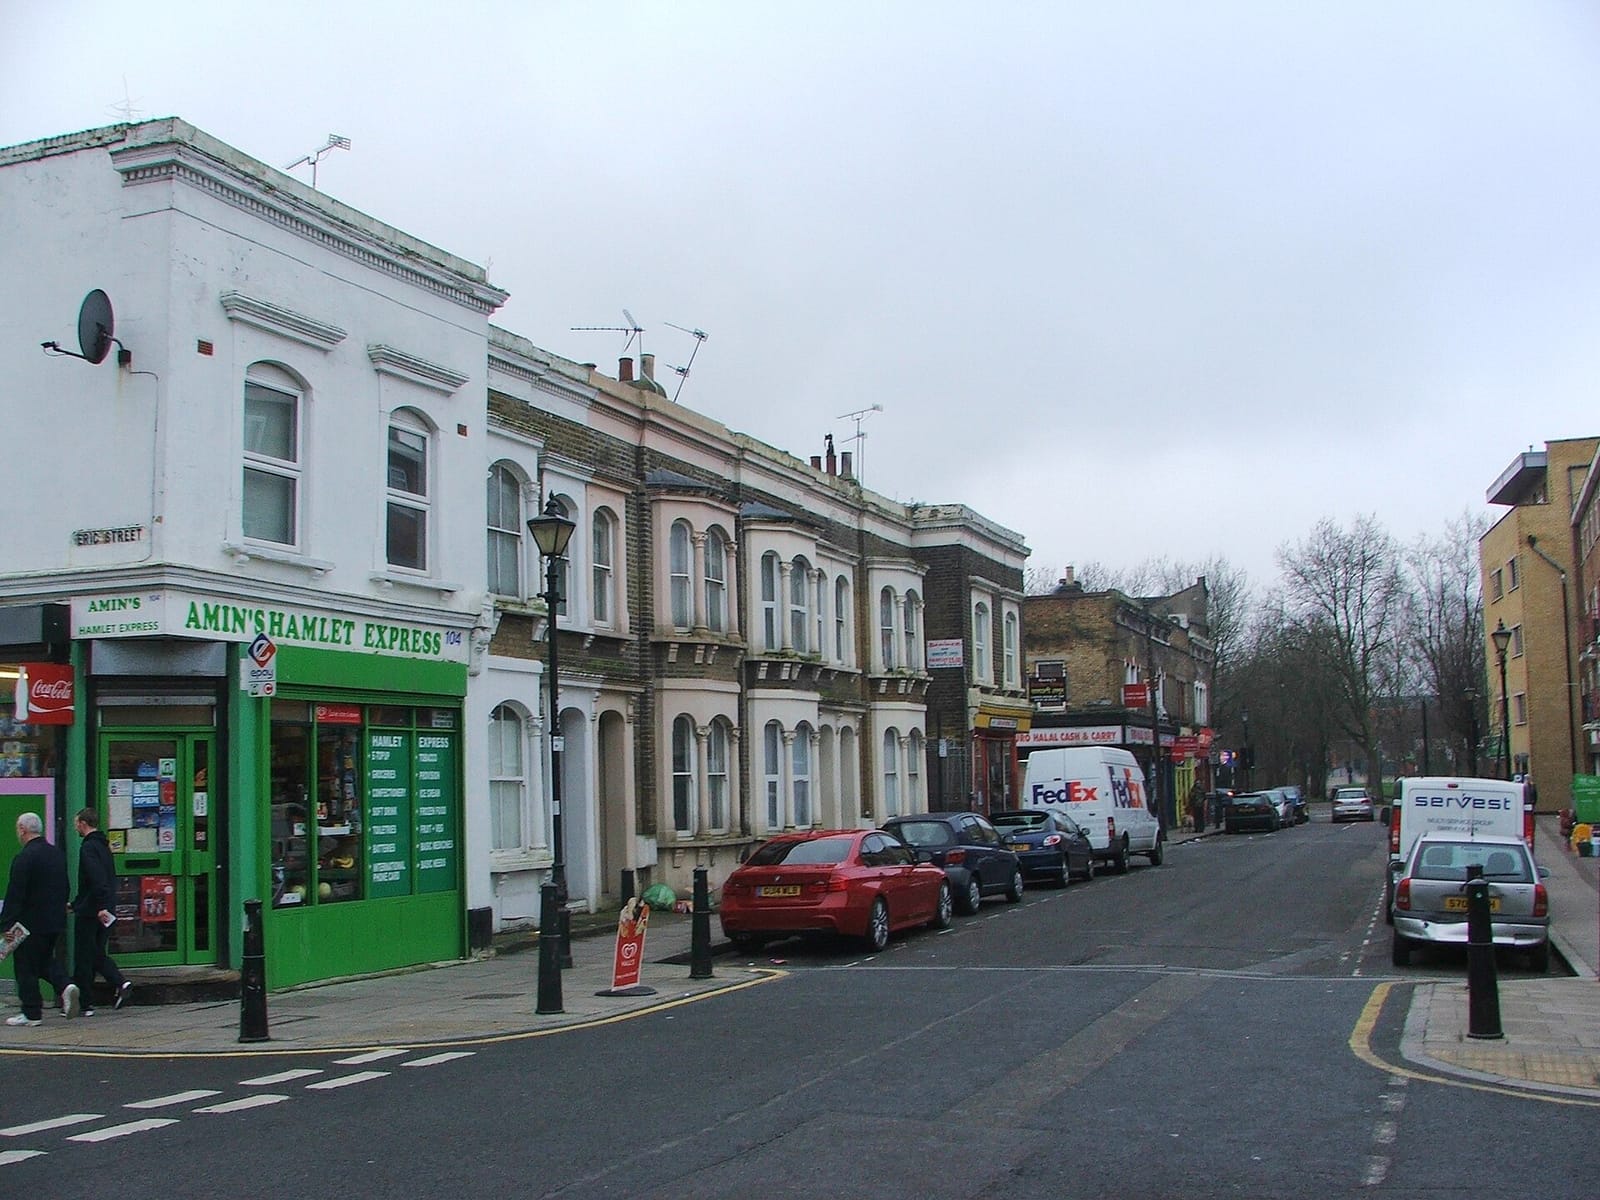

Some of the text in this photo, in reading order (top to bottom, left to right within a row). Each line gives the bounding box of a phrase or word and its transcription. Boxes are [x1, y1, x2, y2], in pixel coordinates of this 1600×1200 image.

[77, 528, 142, 546] ERIC STREET
[87, 598, 141, 612] AMIN'S
[79, 621, 159, 635] HAMLET EXPRESS
[185, 601, 462, 656] AMIN'S HAMLET EXPRESS 104
[250, 669, 274, 679] epay
[372, 735, 403, 748] HAMLET
[418, 736, 449, 749] EXPRESS
[1015, 732, 1031, 743] URO
[1033, 732, 1059, 743] HALAL
[1060, 731, 1081, 741] CASH
[1083, 731, 1089, 741] &
[1091, 730, 1118, 741] CARRY
[1032, 781, 1098, 805] FedEx
[1414, 793, 1510, 810] servest
